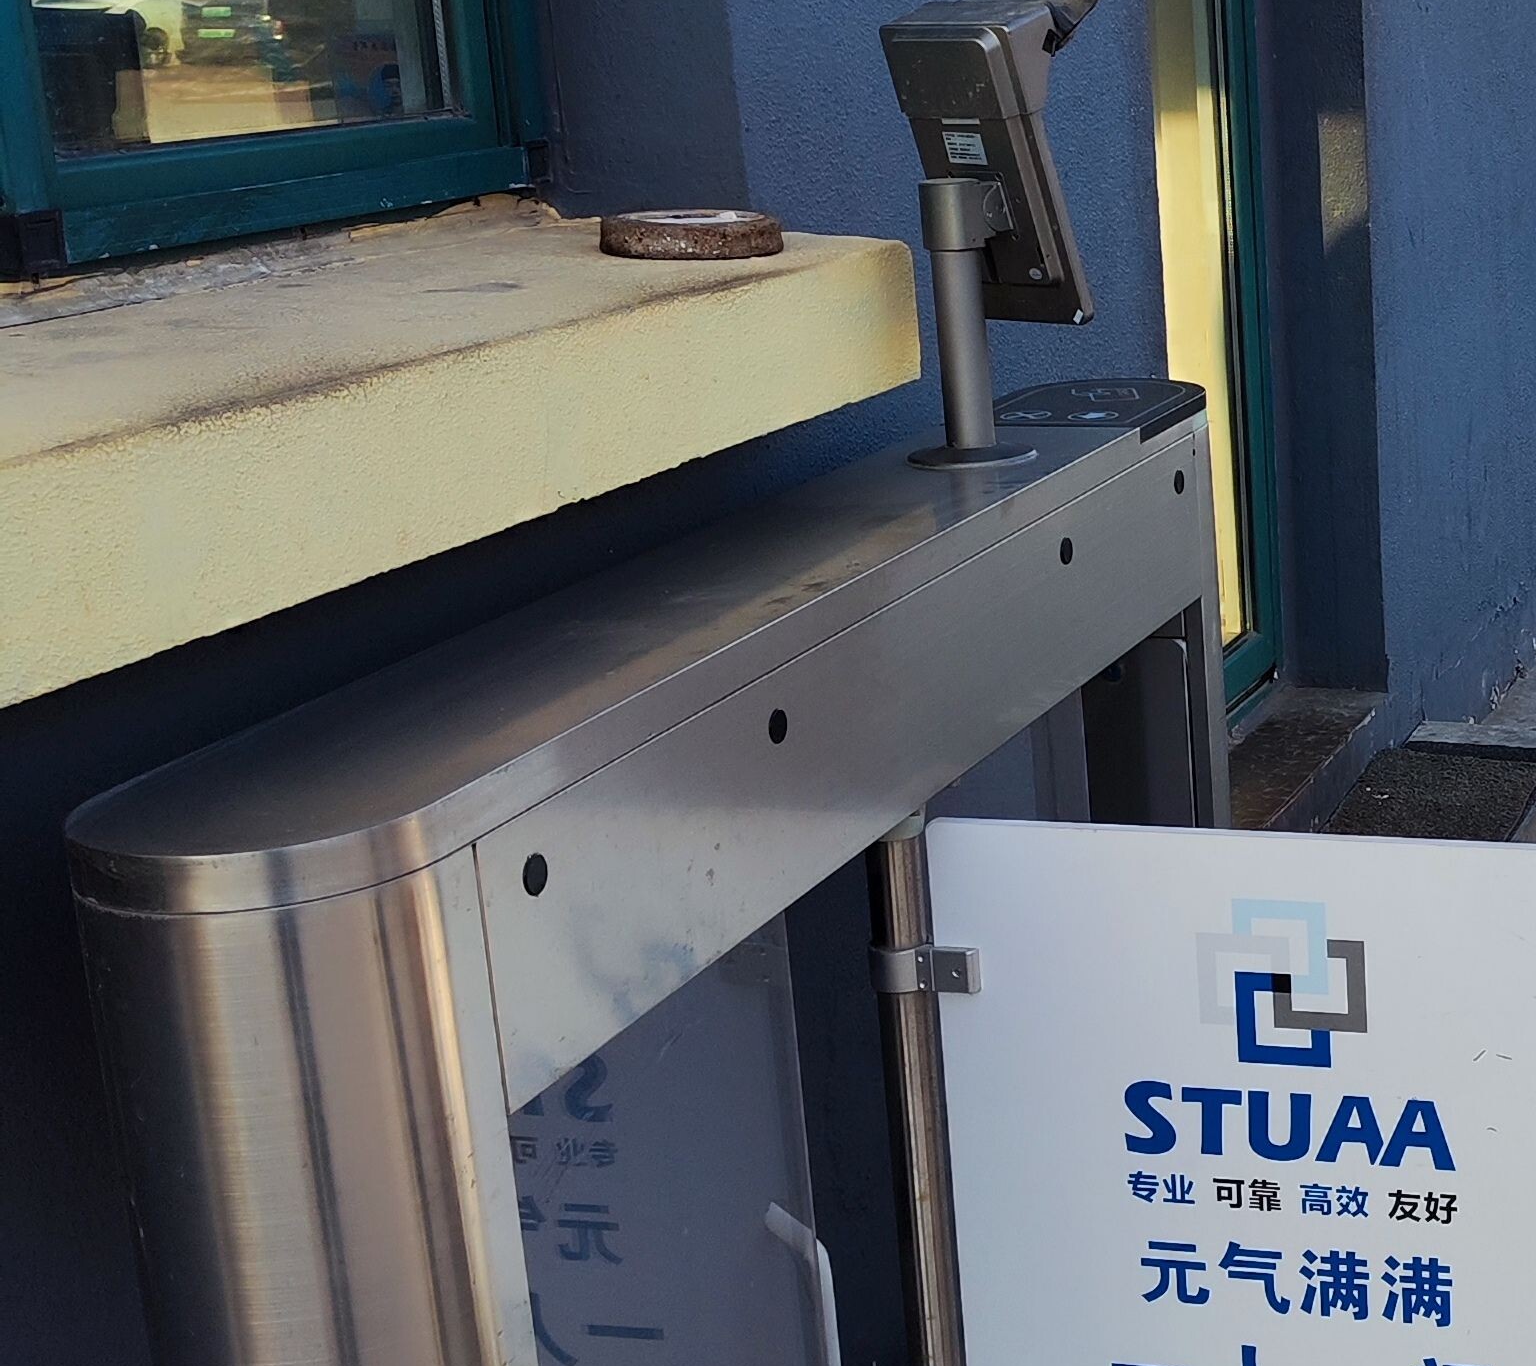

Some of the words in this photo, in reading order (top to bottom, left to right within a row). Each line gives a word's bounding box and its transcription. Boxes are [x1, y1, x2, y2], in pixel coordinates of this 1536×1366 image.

[1124, 1080, 1456, 1171] STUAA
[1127, 1171, 1195, 1204] 专业
[1213, 1177, 1282, 1212] 可靠
[1300, 1184, 1369, 1218] 高效
[1387, 1189, 1458, 1224] 友好
[1140, 1241, 1453, 1327] 元气满满
